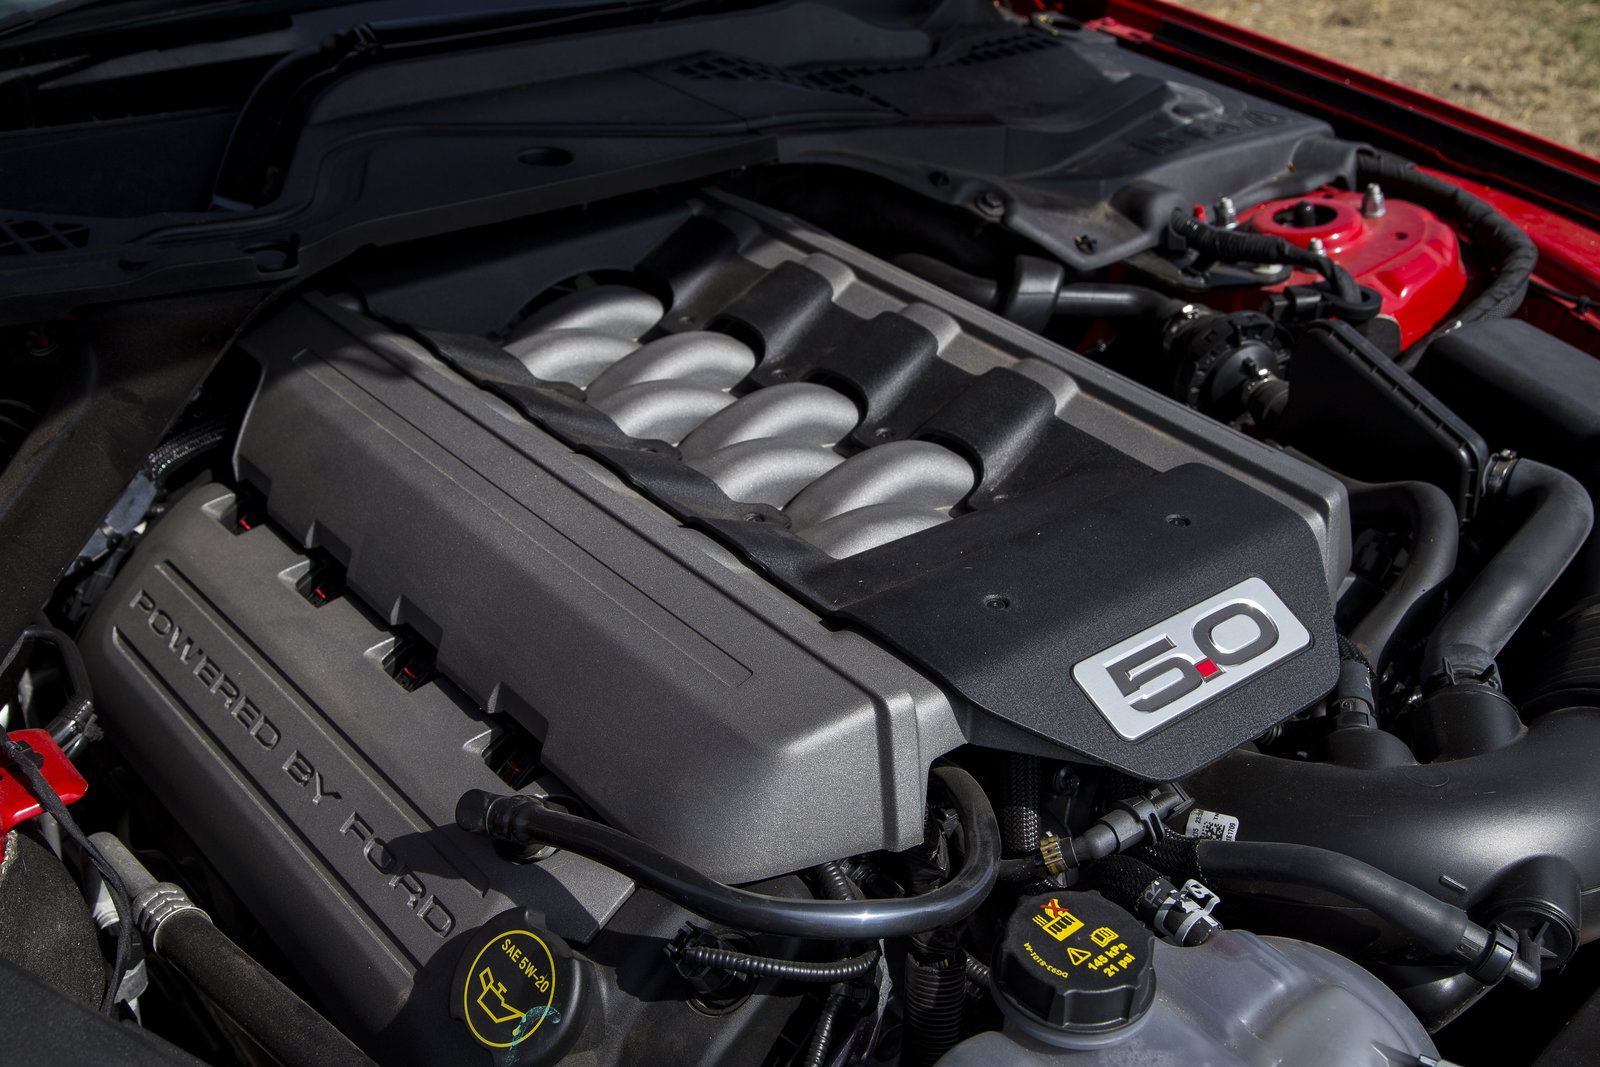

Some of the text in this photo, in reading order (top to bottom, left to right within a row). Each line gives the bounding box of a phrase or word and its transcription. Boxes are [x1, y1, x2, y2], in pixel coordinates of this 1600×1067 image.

[1102, 598, 1280, 713] 5.0
[130, 589, 456, 938] POWERED BY FORD
[501, 939, 550, 993] SAE 5W-20
[1087, 942, 1128, 971] 145 kPa
[1103, 953, 1136, 977] 21 psi
